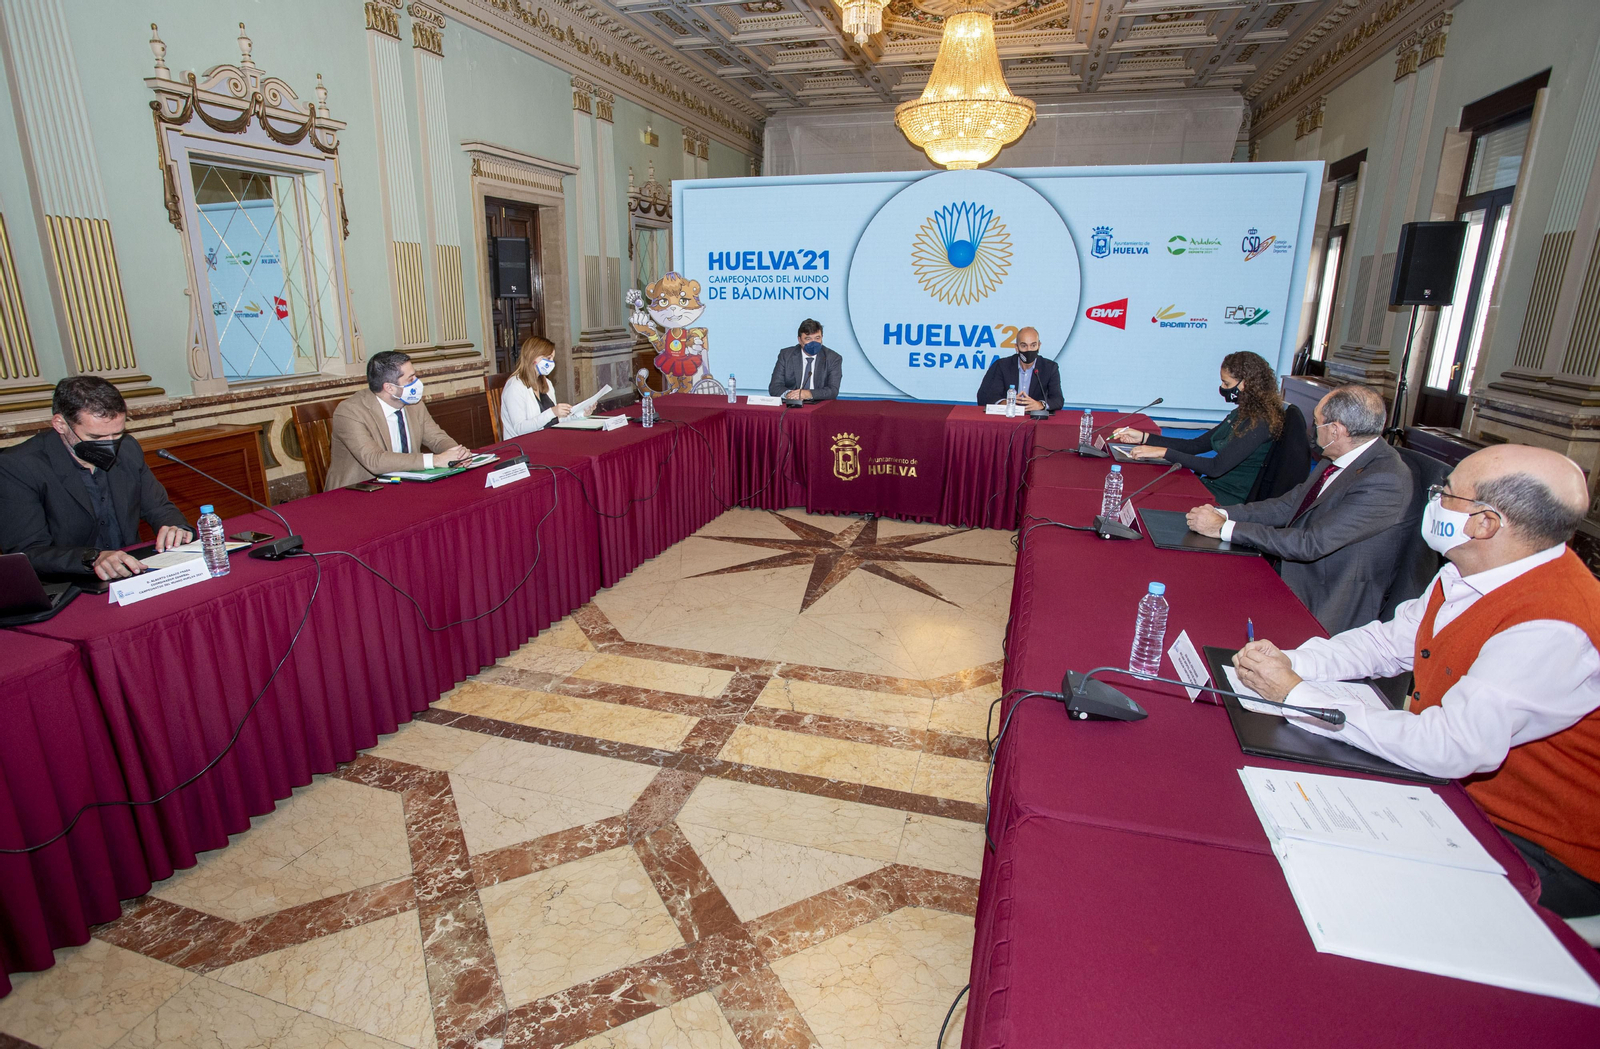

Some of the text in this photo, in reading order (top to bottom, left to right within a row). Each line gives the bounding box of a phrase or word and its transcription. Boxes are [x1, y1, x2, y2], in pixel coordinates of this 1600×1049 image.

[1241, 236, 1261, 253] CSD
[1112, 247, 1149, 255] HUELVA
[708, 275, 830, 284] CAMPEONATOS DEL MUNDO
[708, 283, 829, 300] DE BÁDMINTON
[1090, 308, 1125, 318] BWF
[1160, 321, 1208, 329] BADMINTON
[868, 464, 918, 477] HUELVA
[1430, 519, 1455, 537] M10
